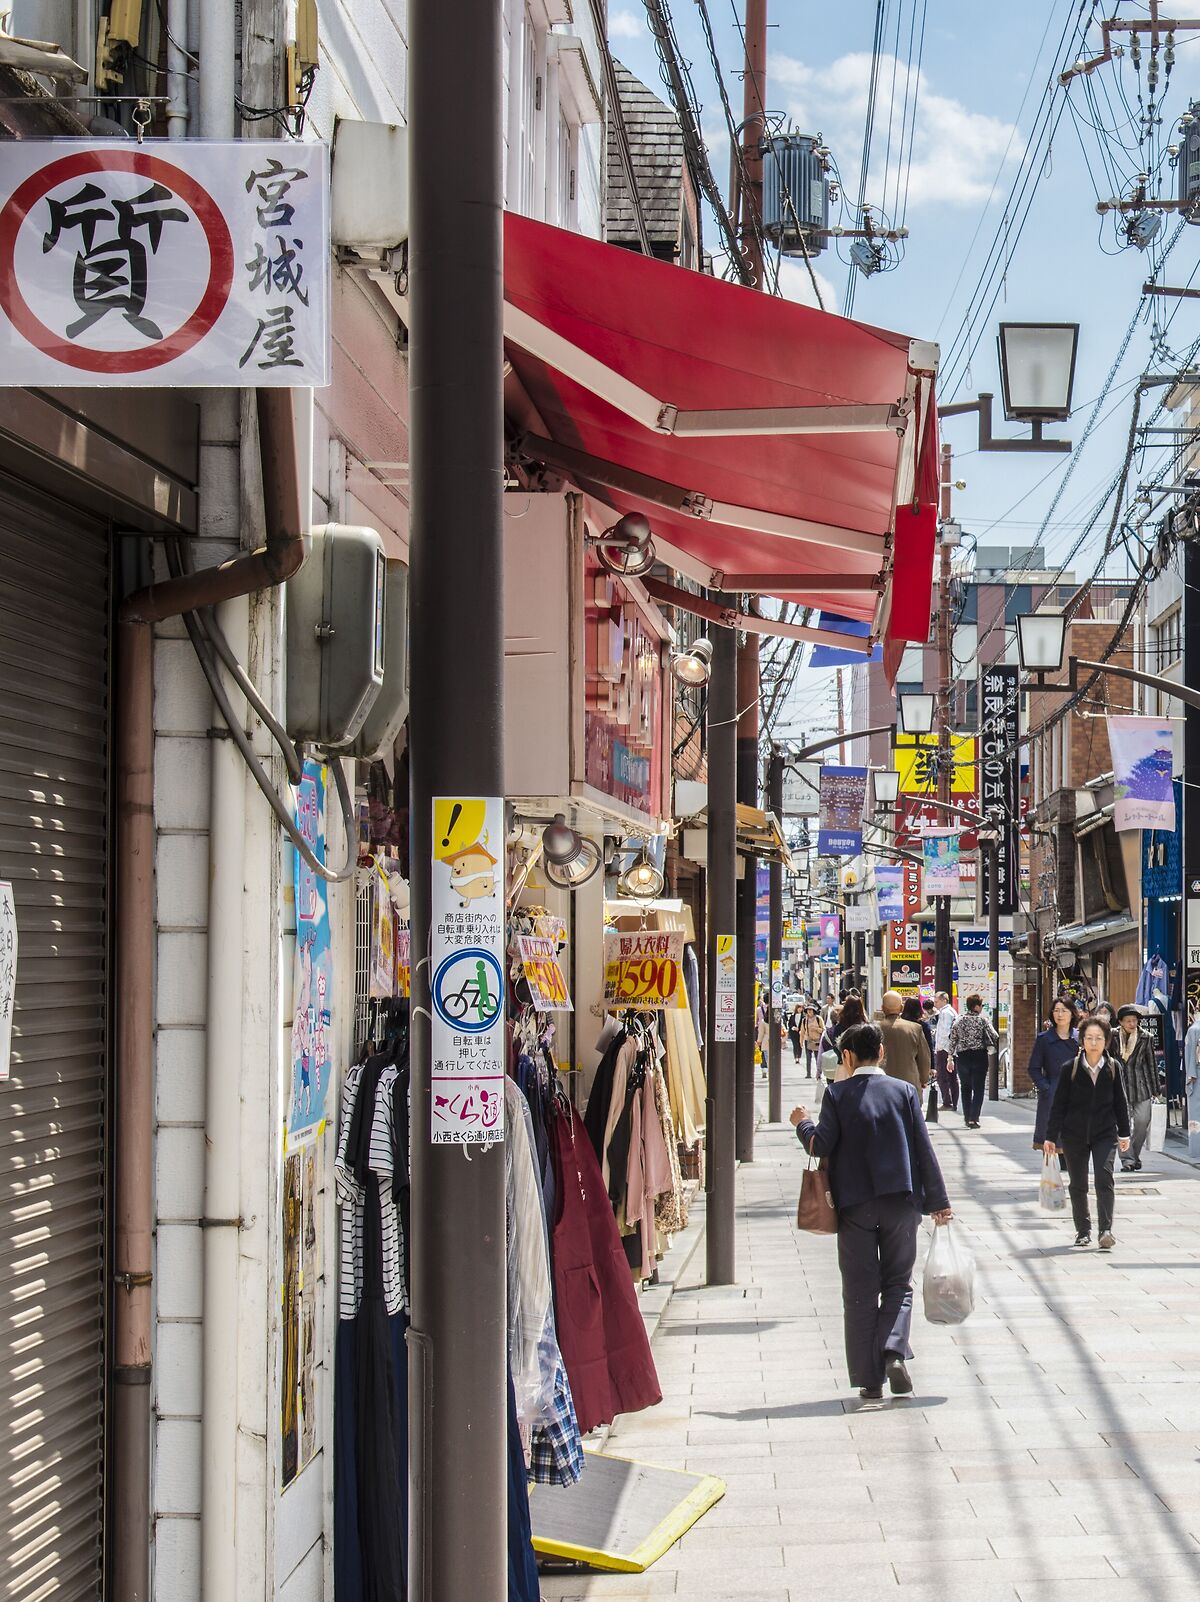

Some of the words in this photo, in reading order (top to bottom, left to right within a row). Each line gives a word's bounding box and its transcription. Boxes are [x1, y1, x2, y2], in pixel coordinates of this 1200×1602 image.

[43, 182, 190, 340] 質
[239, 159, 310, 371] 宮城屋
[984, 675, 1005, 904] 奈良きもの芸術
[908, 861, 918, 905] コミック
[444, 913, 497, 924] 商店街内への
[437, 924, 501, 934] 自転車乗り入れは
[444, 935, 497, 945] 大変危険です
[620, 936, 670, 955] 婦人衣料
[616, 959, 677, 998] ¥590
[452, 1036, 491, 1046] 自転車は
[458, 1048, 487, 1058] 押して
[434, 1060, 503, 1071] 通行してください
